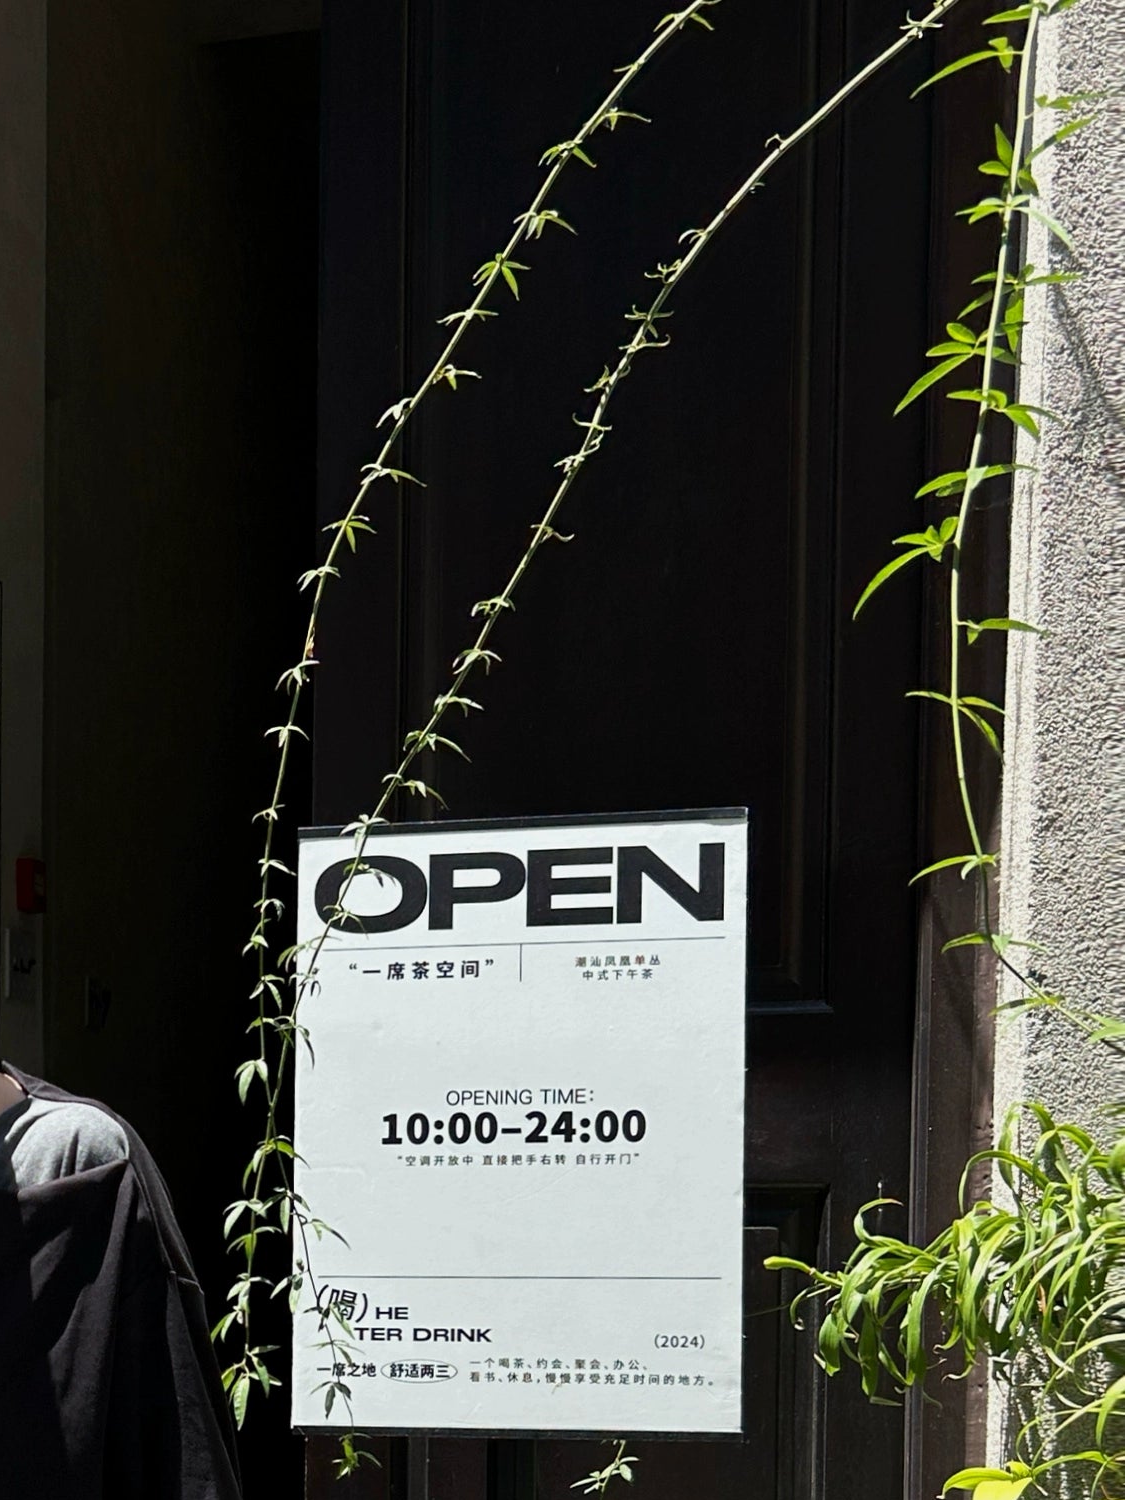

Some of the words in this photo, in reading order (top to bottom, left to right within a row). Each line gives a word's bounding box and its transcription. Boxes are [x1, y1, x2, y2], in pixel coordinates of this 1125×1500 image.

[314, 842, 725, 934] OPEN
[581, 968, 654, 981] 中式下午茶
[445, 1089, 533, 1106] OPENING
[540, 1088, 594, 1105] TIME:
[482, 1153, 567, 1166] 直接把手右转
[375, 1306, 409, 1320] HE
[353, 1327, 403, 1342] TER
[412, 1328, 492, 1343] DRINK
[316, 1362, 377, 1378] 一席之地
[389, 1363, 451, 1379] 舒适两三
